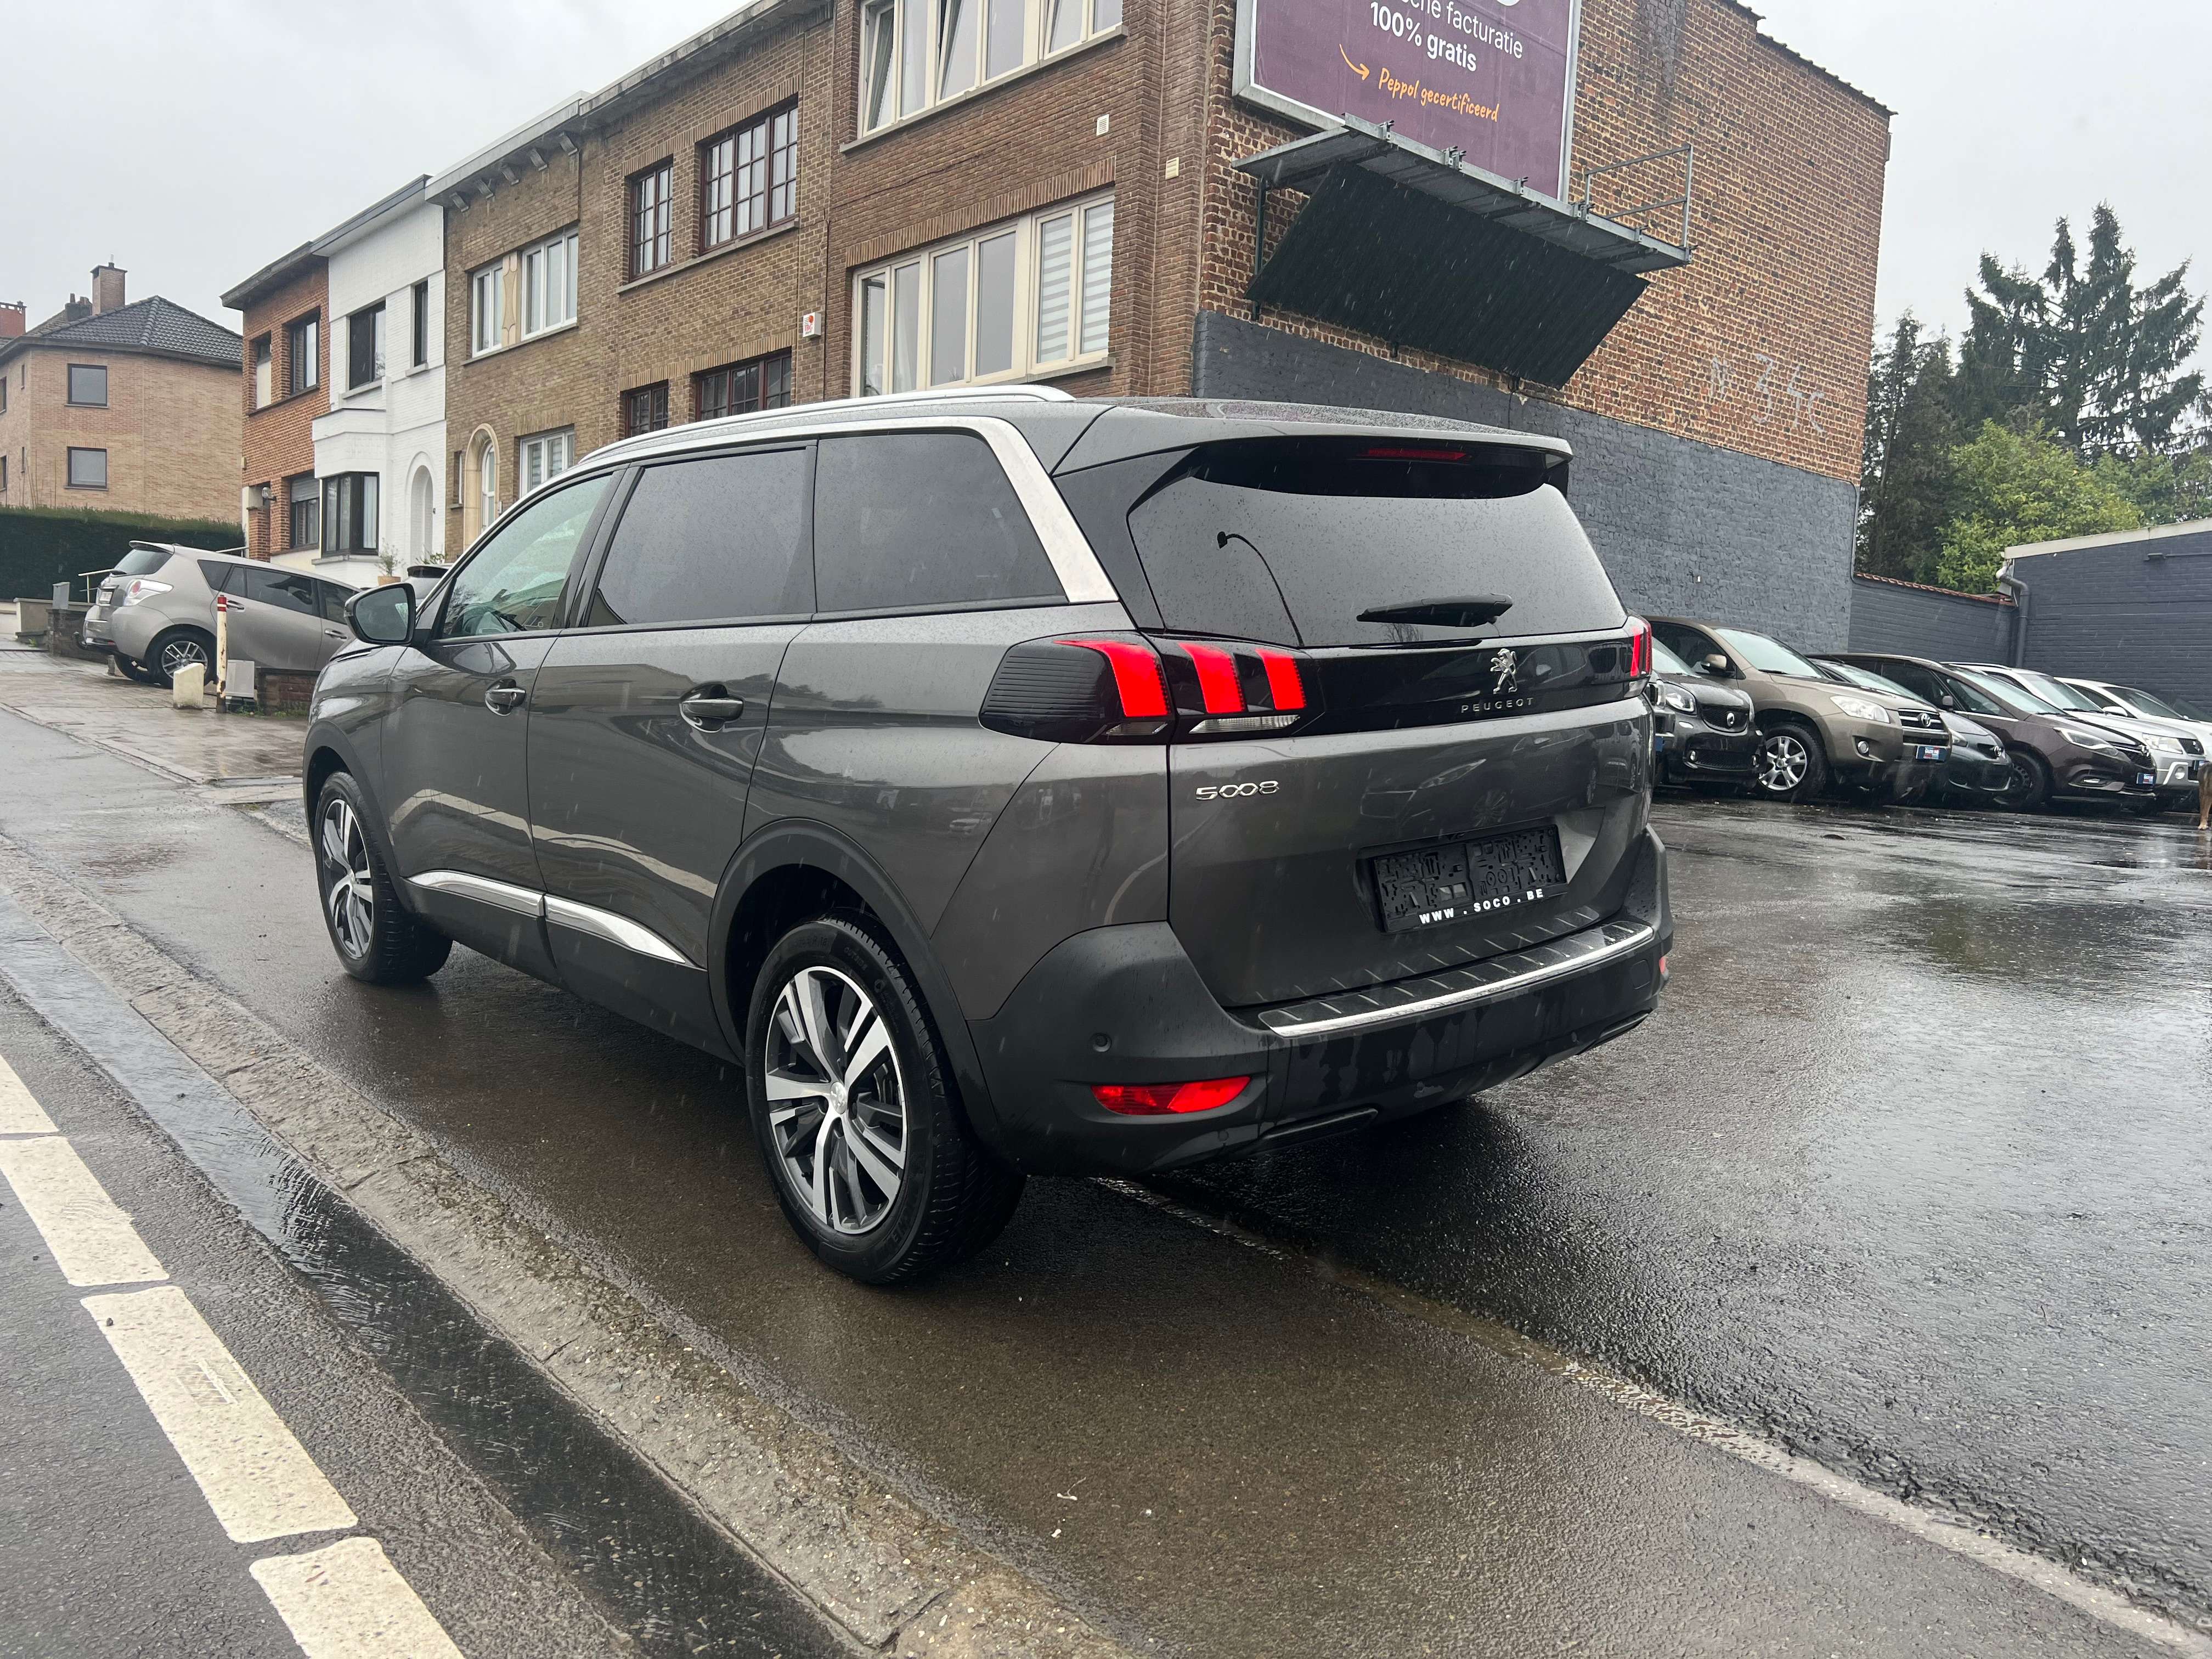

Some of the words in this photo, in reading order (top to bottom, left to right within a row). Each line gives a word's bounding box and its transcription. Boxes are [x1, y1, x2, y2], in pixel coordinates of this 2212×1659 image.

[1370, 1, 1422, 47] 100%
[1427, 34, 1477, 72] gratis
[1446, 2, 1523, 59] facturatie
[1378, 67, 1420, 99] Peppol
[1420, 87, 1500, 122] gecertificeerd
[1460, 697, 1534, 714] PEUGEOT
[1195, 780, 1279, 801] 5008
